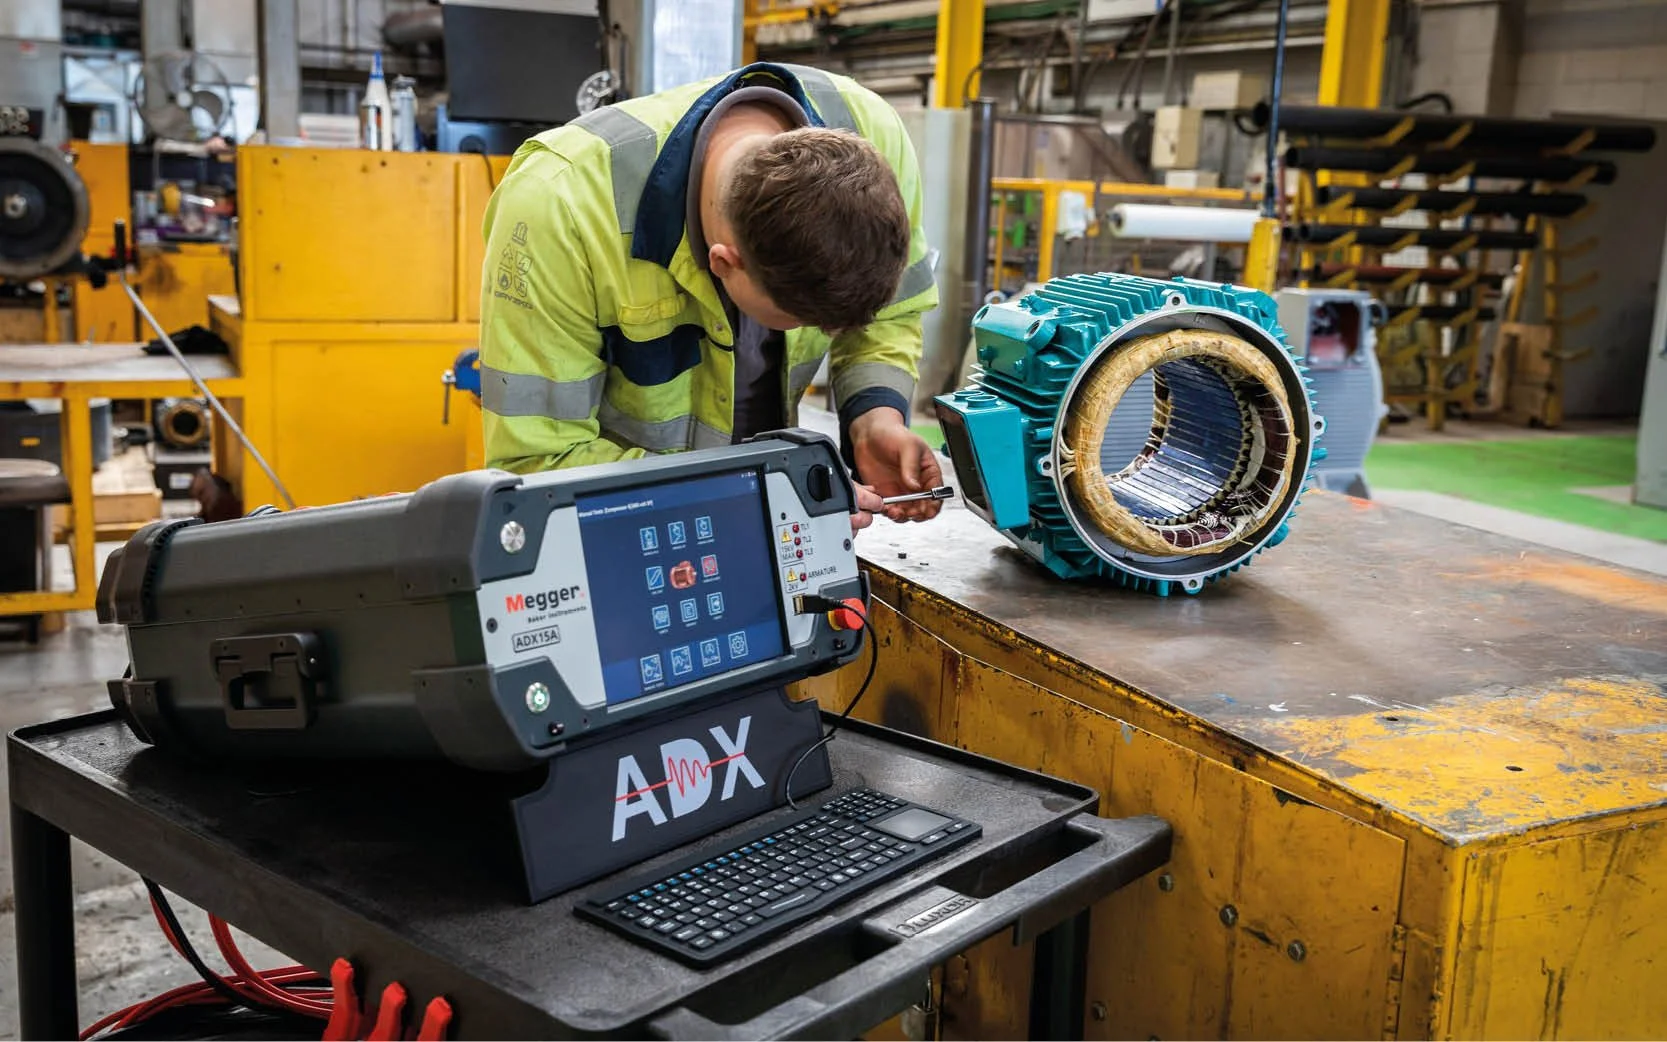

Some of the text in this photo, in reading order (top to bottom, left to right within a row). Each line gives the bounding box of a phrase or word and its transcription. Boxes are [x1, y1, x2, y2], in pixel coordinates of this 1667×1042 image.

[808, 566, 838, 579] ARMATURE
[516, 629, 558, 648] ADX15A
[612, 715, 766, 842] ADX
